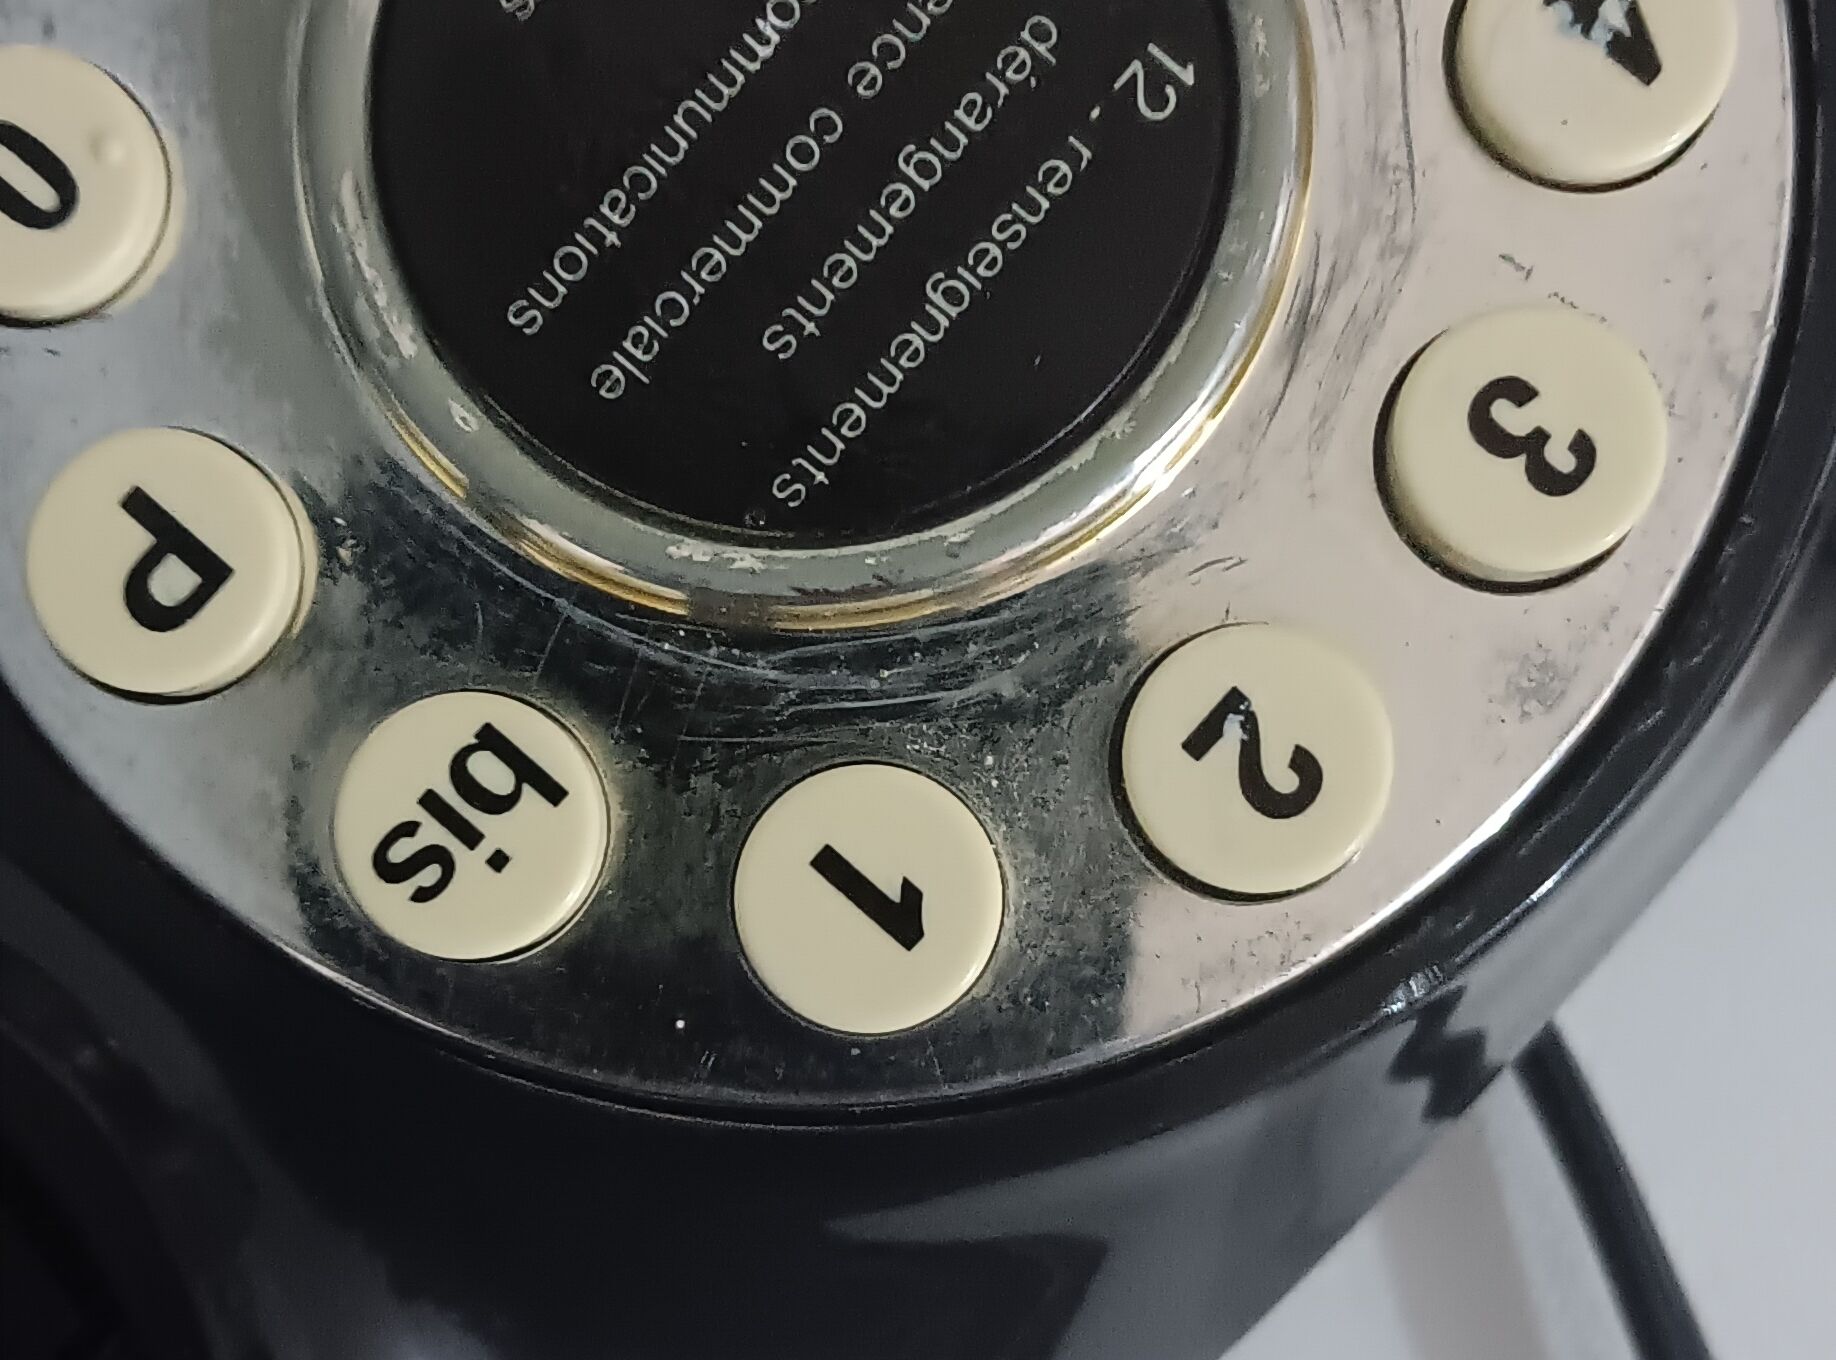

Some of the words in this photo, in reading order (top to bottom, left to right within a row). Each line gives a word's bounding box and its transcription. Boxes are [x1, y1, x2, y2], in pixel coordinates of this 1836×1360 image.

[0, 119, 80, 231] 0
[762, 14, 1059, 360] dérangements
[590, 107, 844, 401] commerciale
[772, 135, 1094, 509] renseignements
[1467, 375, 1597, 497] 3
[118, 485, 235, 633] P
[370, 722, 570, 905] bis
[1180, 685, 1324, 820] 2
[809, 843, 926, 952] 1
